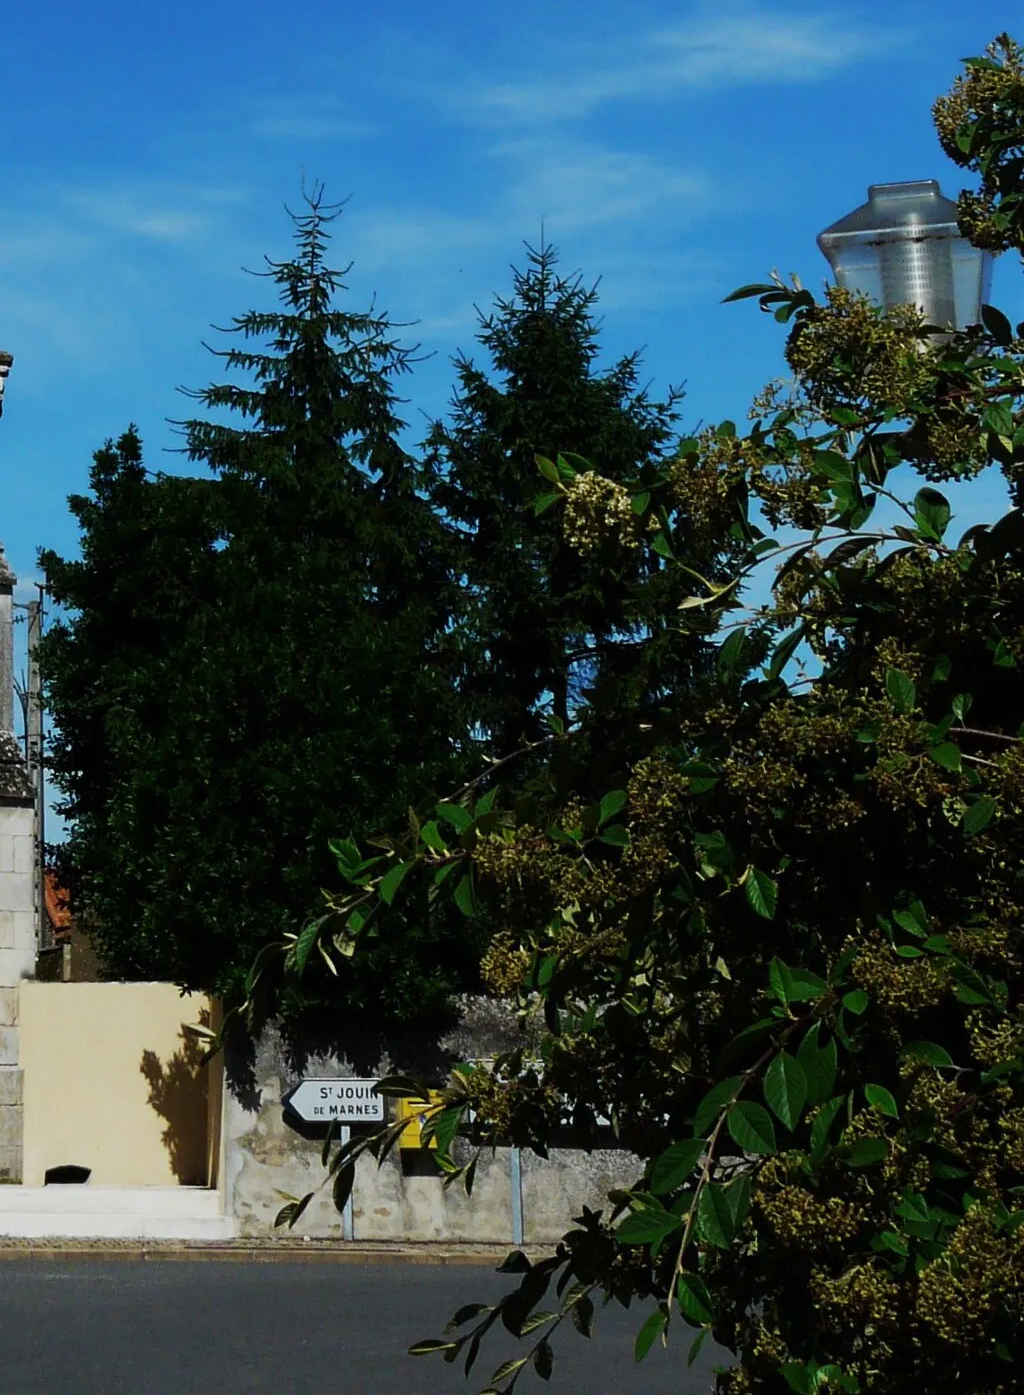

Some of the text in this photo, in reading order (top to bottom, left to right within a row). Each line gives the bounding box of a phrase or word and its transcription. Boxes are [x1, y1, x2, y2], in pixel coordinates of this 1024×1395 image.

[336, 1087, 378, 1099] JOUIN
[313, 1105, 379, 1115] DE MARNES
